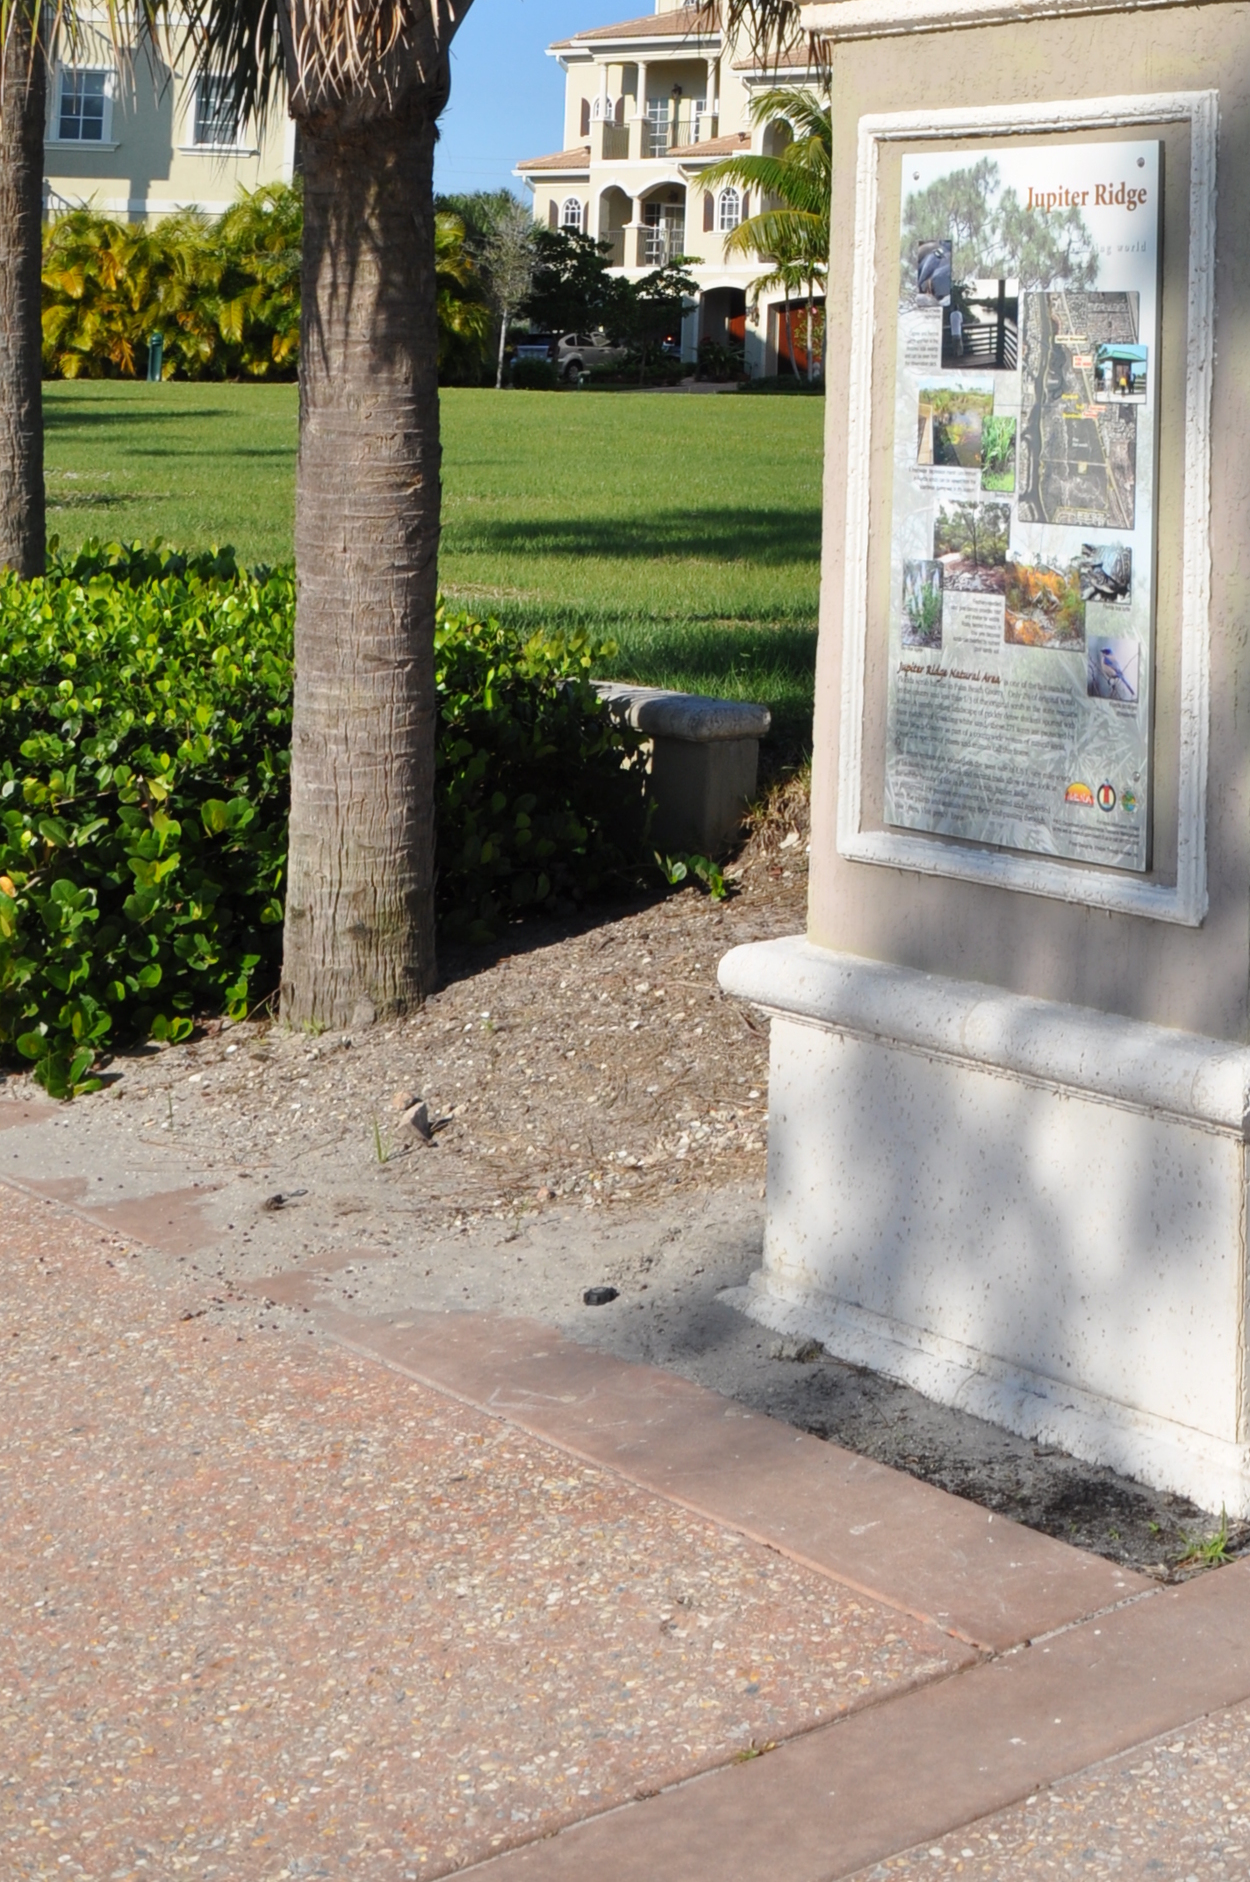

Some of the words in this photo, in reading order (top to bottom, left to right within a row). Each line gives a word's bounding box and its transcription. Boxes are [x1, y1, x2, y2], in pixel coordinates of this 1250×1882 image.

[1026, 185, 1089, 213] Jupiter
[1094, 181, 1147, 211] Ridge
[1117, 241, 1147, 253] world
[897, 661, 924, 680] Jupiter
[926, 663, 948, 682] Ridge
[950, 666, 980, 682] Natural
[981, 669, 1001, 684] Area
